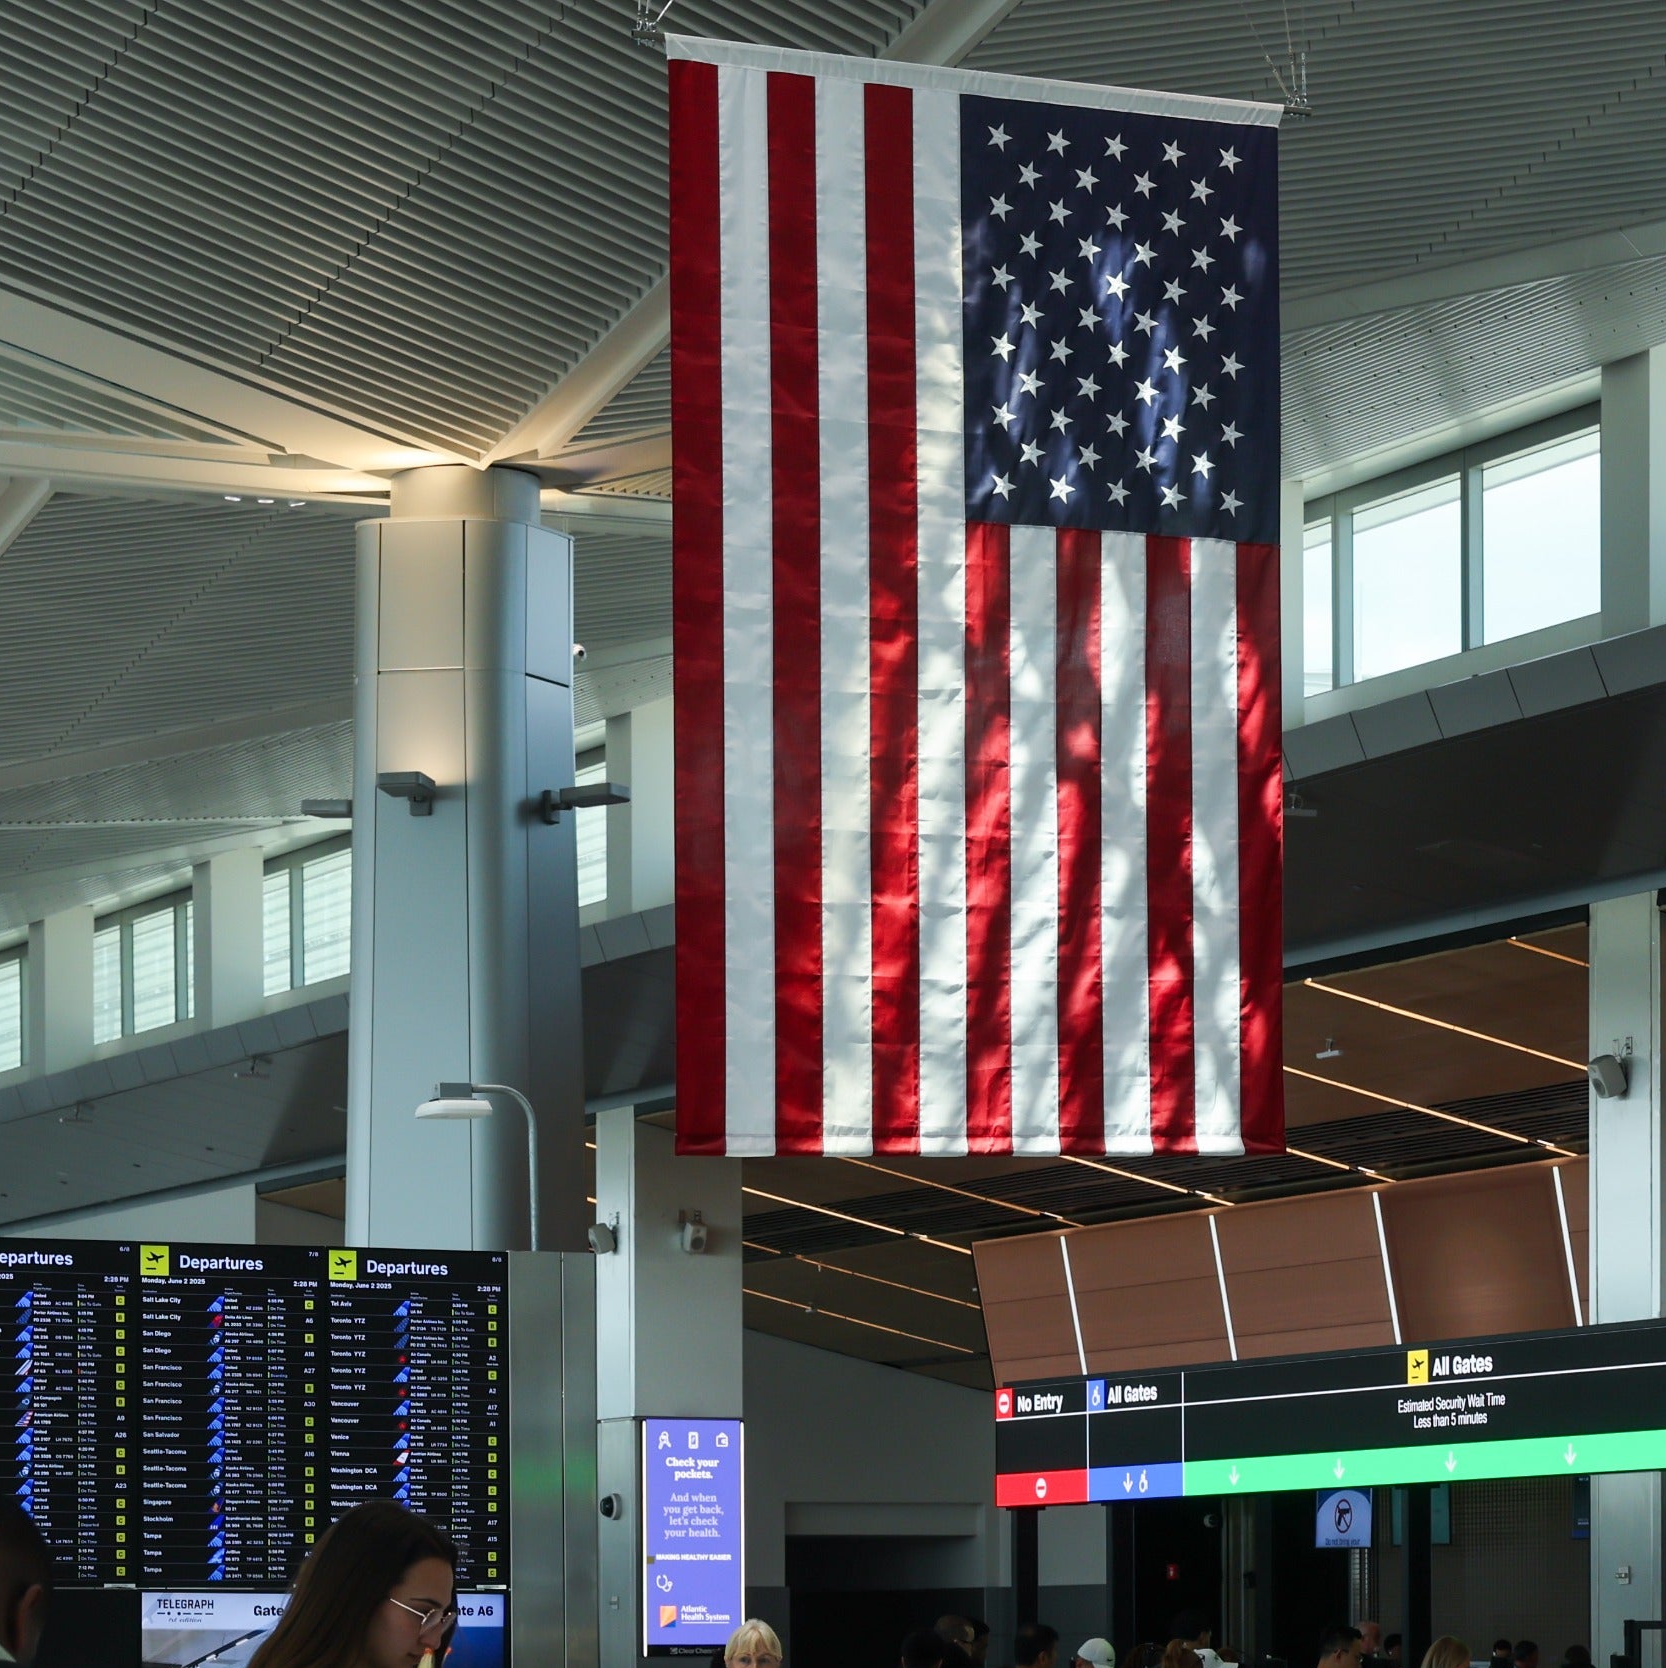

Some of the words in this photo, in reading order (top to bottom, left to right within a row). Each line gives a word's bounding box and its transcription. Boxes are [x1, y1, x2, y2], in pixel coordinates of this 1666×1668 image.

[179, 1254, 264, 1272] Departures
[366, 1259, 448, 1276] Departures
[1433, 1356, 1449, 1376] All
[1453, 1354, 1493, 1375] Gates
[1108, 1385, 1121, 1404] All
[1124, 1384, 1157, 1403] Gates
[1017, 1396, 1032, 1412] No
[1034, 1393, 1063, 1413] Entry
[1398, 1397, 1434, 1413] Estimated
[1435, 1396, 1466, 1411] Security
[1467, 1393, 1485, 1408] Wait
[1486, 1393, 1505, 1406] Time
[1414, 1415, 1431, 1428] Less
[1433, 1413, 1449, 1426] than
[1451, 1412, 1456, 1426] 5
[1458, 1411, 1487, 1425] minutes
[666, 1457, 695, 1467] Check
[697, 1459, 719, 1469] your
[674, 1469, 713, 1481] pockets.
[670, 1493, 689, 1502] And
[691, 1493, 716, 1502] when
[663, 1506, 680, 1516] you
[683, 1506, 698, 1516] get
[700, 1505, 724, 1515] back,
[691, 1517, 718, 1525] check
[144, 1532, 162, 1541] Tampa
[665, 1529, 686, 1539] your
[689, 1528, 720, 1537] health.
[157, 1599, 214, 1609] TELEGRAPH
[254, 1606, 284, 1616] Gate
[478, 1606, 493, 1616] A6
[706, 1614, 730, 1622] System
